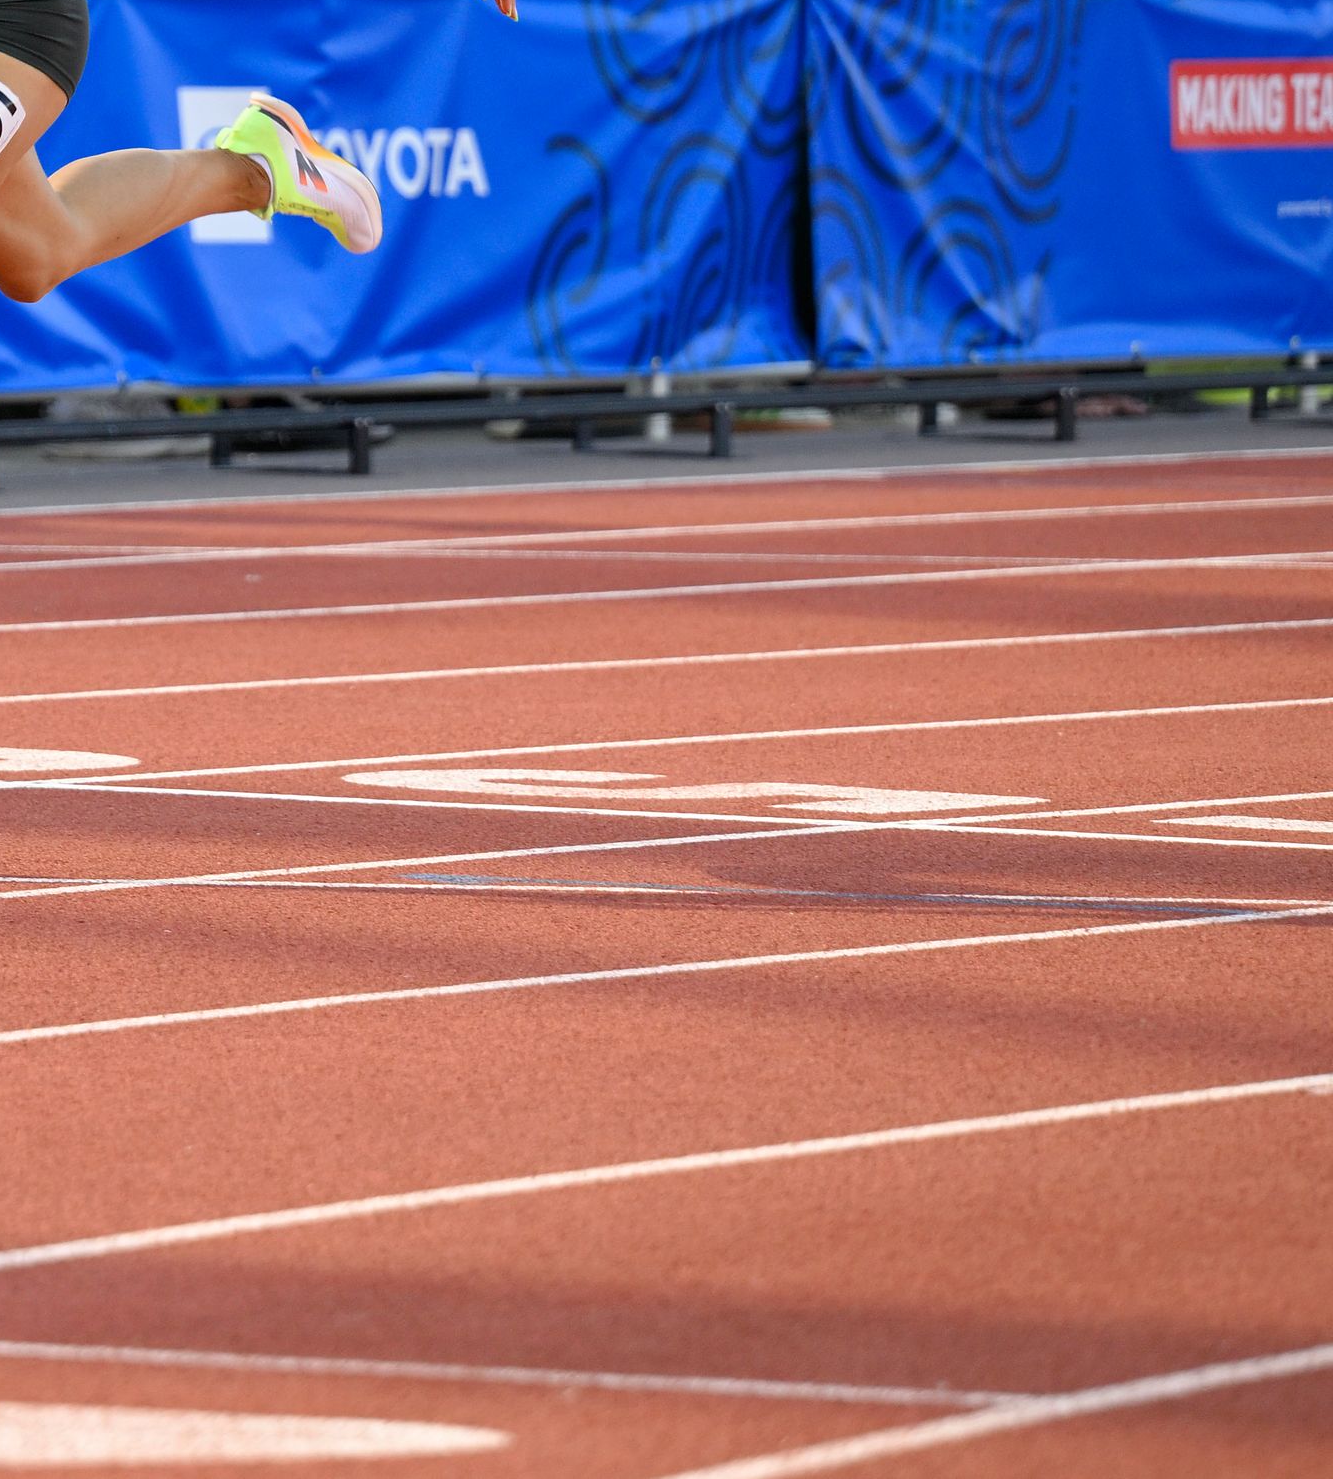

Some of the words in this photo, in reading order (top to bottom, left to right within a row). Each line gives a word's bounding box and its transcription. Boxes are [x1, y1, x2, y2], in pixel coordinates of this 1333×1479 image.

[1177, 73, 1283, 135] MAKING
[315, 126, 491, 199] OYOTA
[341, 768, 1050, 815] 5
